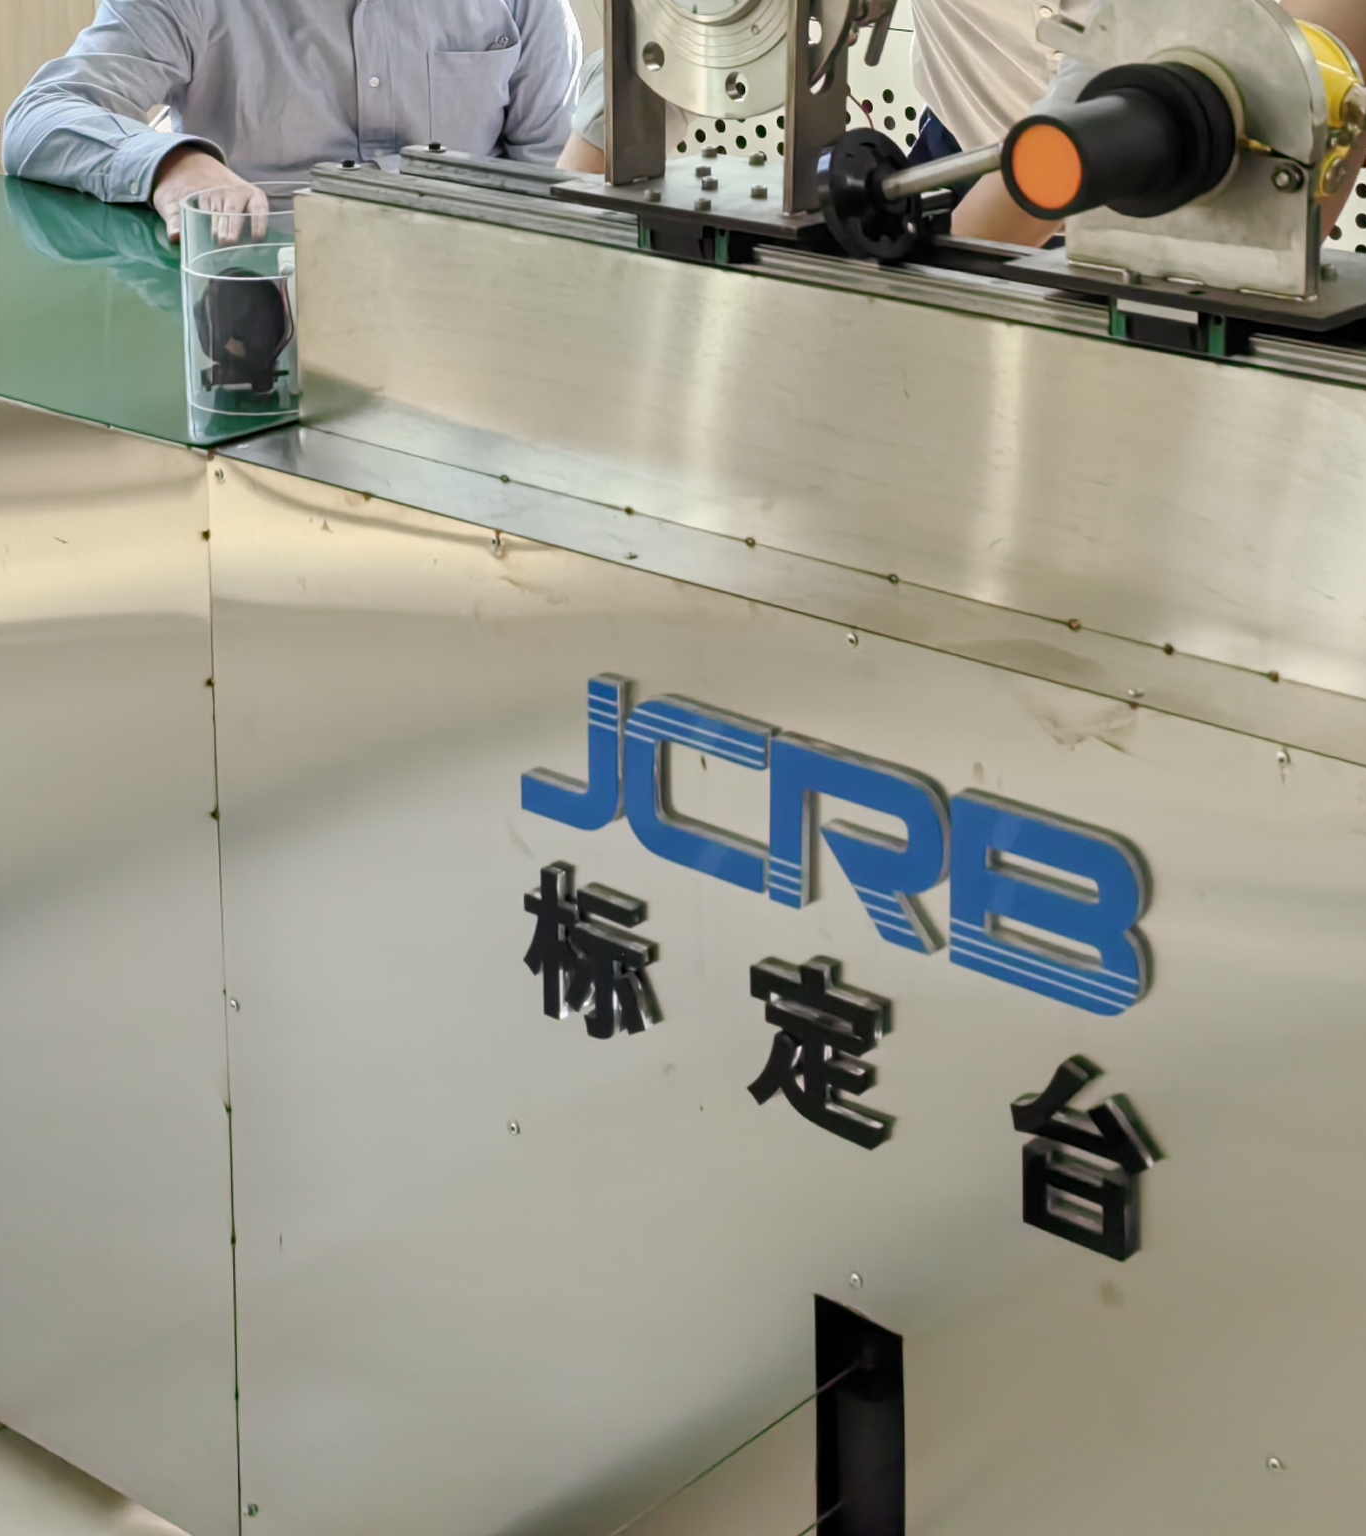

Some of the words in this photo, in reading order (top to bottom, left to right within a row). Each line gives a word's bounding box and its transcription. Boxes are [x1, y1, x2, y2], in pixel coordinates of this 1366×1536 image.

[521, 672, 1154, 1017] JCRB
[523, 860, 1165, 1262] 标定台
